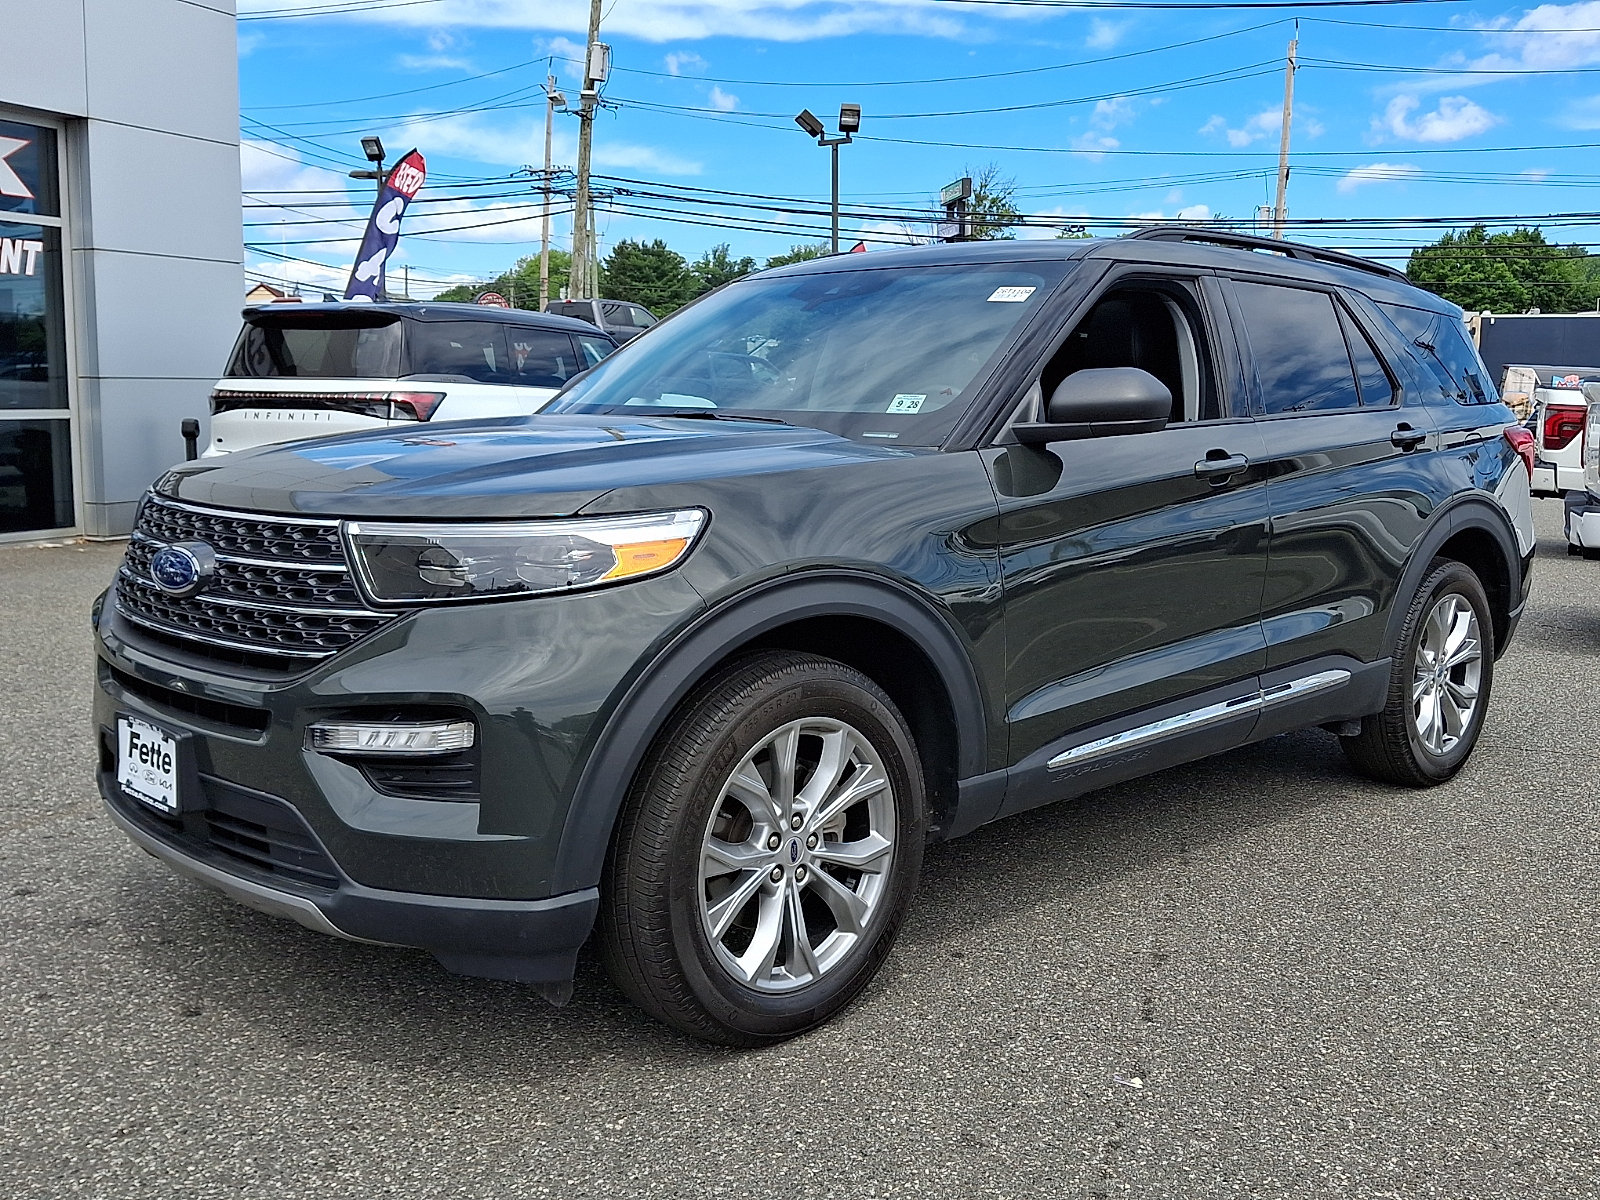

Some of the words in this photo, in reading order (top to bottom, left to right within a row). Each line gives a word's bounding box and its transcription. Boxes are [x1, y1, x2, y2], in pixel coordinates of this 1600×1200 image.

[394, 162, 424, 194] USED
[0, 238, 43, 275] NT
[244, 411, 331, 421] INFINITI
[896, 400, 904, 408] 9
[907, 400, 920, 409] 28
[128, 730, 172, 775] Fette
